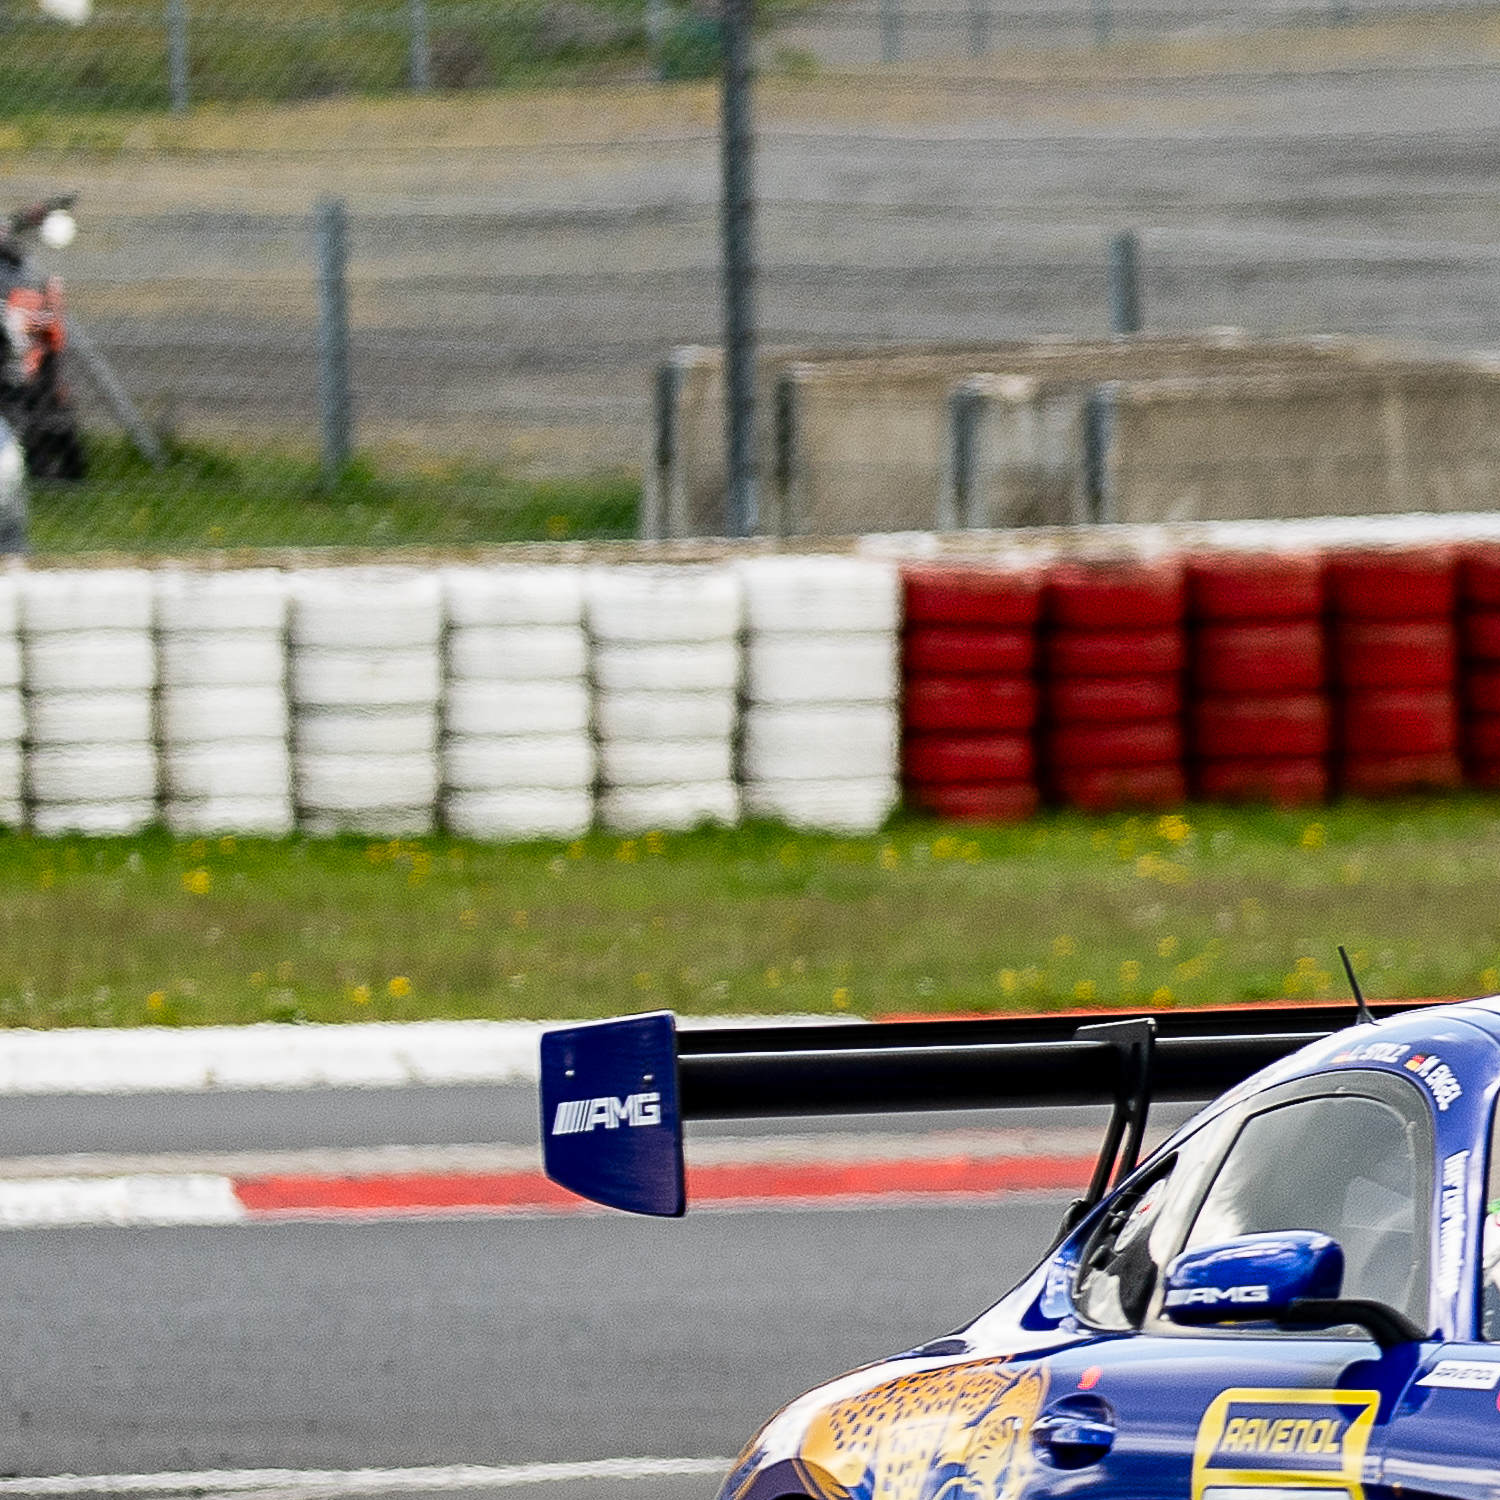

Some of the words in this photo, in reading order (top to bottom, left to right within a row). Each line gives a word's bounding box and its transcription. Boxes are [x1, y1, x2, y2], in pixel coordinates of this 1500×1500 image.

[584, 1091, 661, 1132] AMG
[1185, 1285, 1270, 1305] AMG
[1219, 1417, 1341, 1454] RAVENOL
